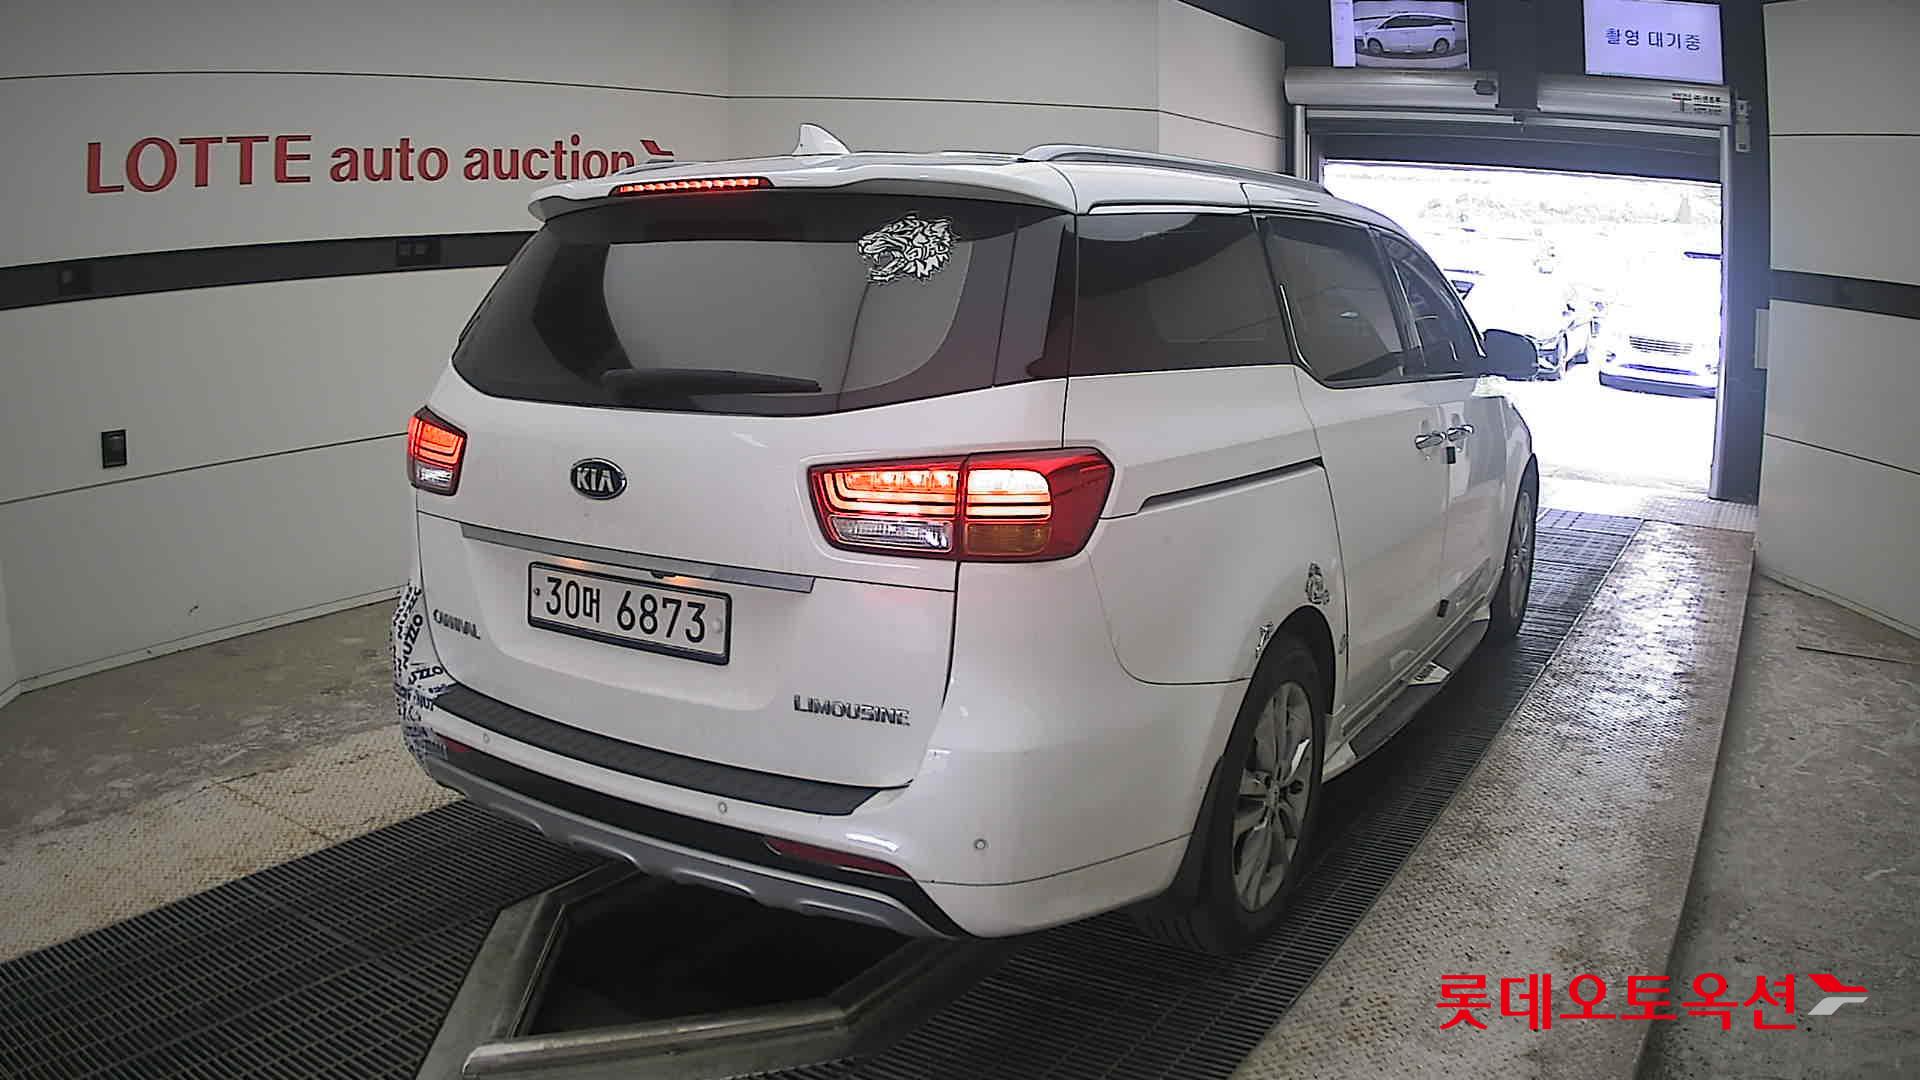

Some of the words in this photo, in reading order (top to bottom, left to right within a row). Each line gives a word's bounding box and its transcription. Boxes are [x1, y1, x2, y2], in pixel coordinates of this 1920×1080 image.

[1647, 31, 1701, 51] 대기중
[87, 134, 313, 194] LOTTE
[329, 138, 449, 182] auto
[463, 134, 635, 181] auction
[576, 467, 615, 493] KIA
[546, 576, 600, 624] 30머
[617, 590, 706, 643] 6873
[794, 694, 911, 727] LIMOUSINE
